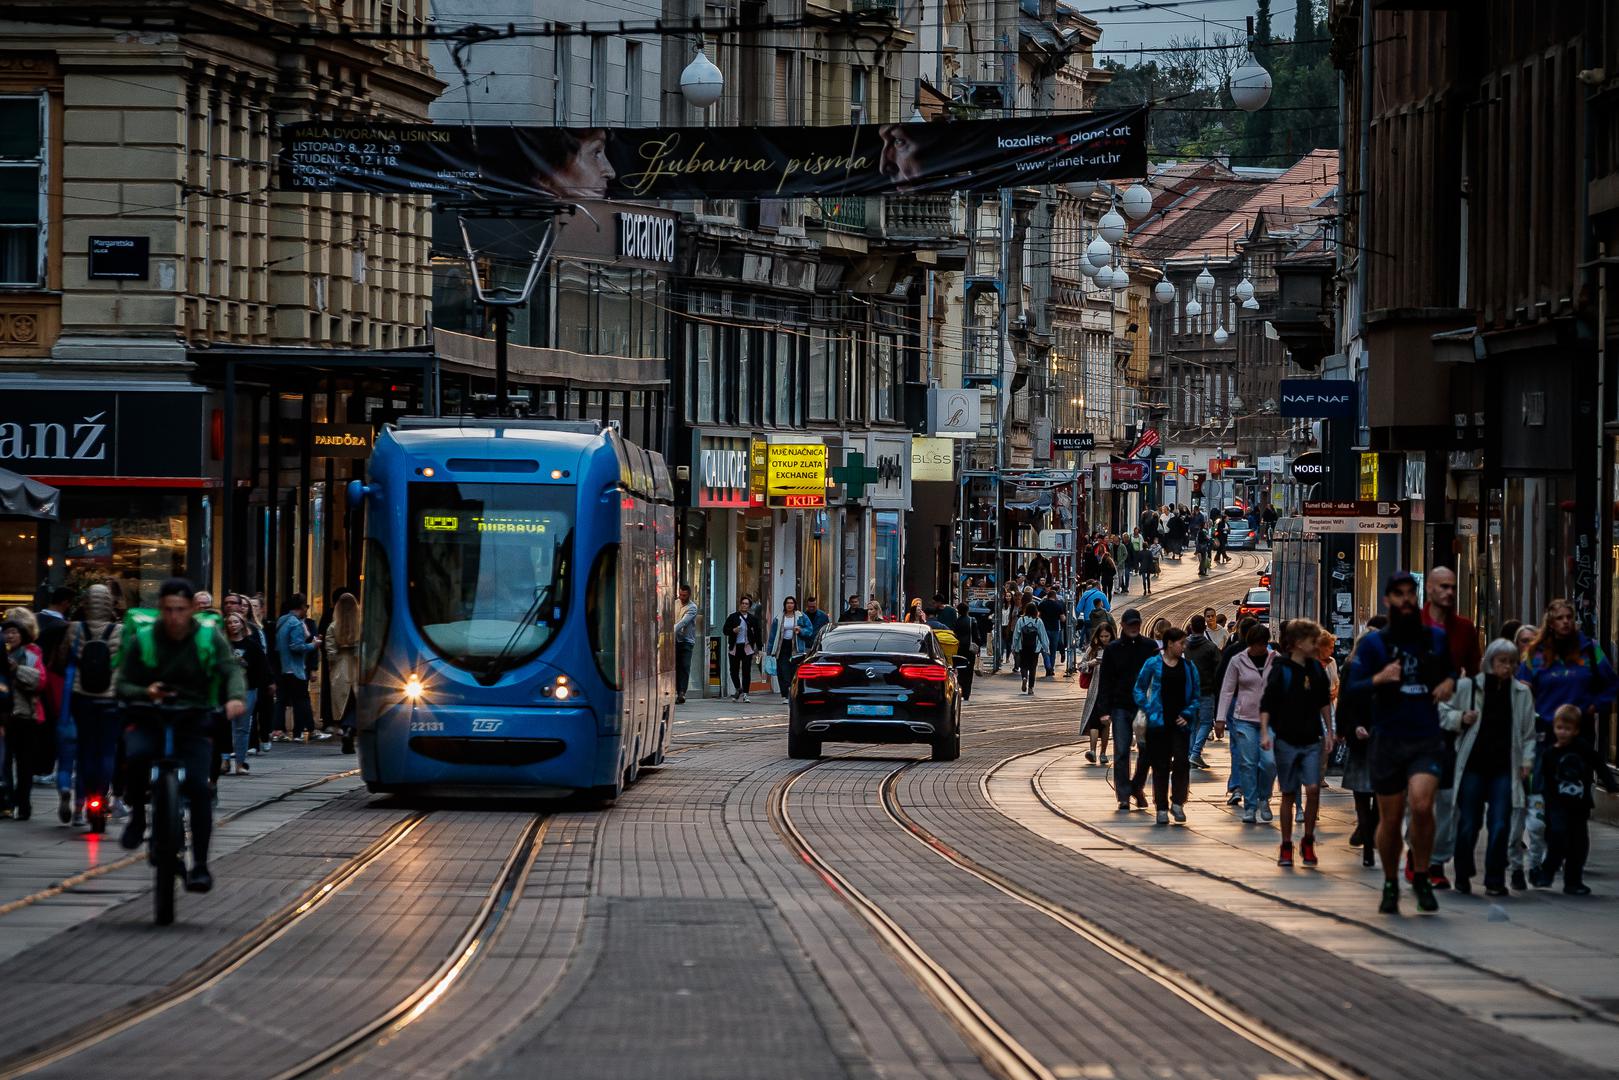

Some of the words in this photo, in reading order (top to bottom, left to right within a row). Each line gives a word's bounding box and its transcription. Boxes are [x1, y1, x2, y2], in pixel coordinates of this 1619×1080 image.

[295, 128, 330, 138] MALA
[334, 128, 397, 140] DVORANA
[400, 130, 450, 142] LISINSKI
[1113, 125, 1132, 136] art
[292, 141, 346, 153] LISTOPAD:
[620, 132, 775, 196] Ljubavna
[776, 151, 874, 194] pisma
[302, 176, 316, 187] 20
[1283, 395, 1314, 403] NAF
[1317, 395, 1350, 403] NAF
[0, 411, 107, 460] anž
[315, 433, 367, 446] PANDORA
[1053, 438, 1091, 446] STRUGAR
[705, 450, 748, 489] CALLIOPE
[772, 460, 799, 468] OTKUP
[776, 471, 819, 479] EXCHANGE
[1359, 521, 1375, 529] Grad
